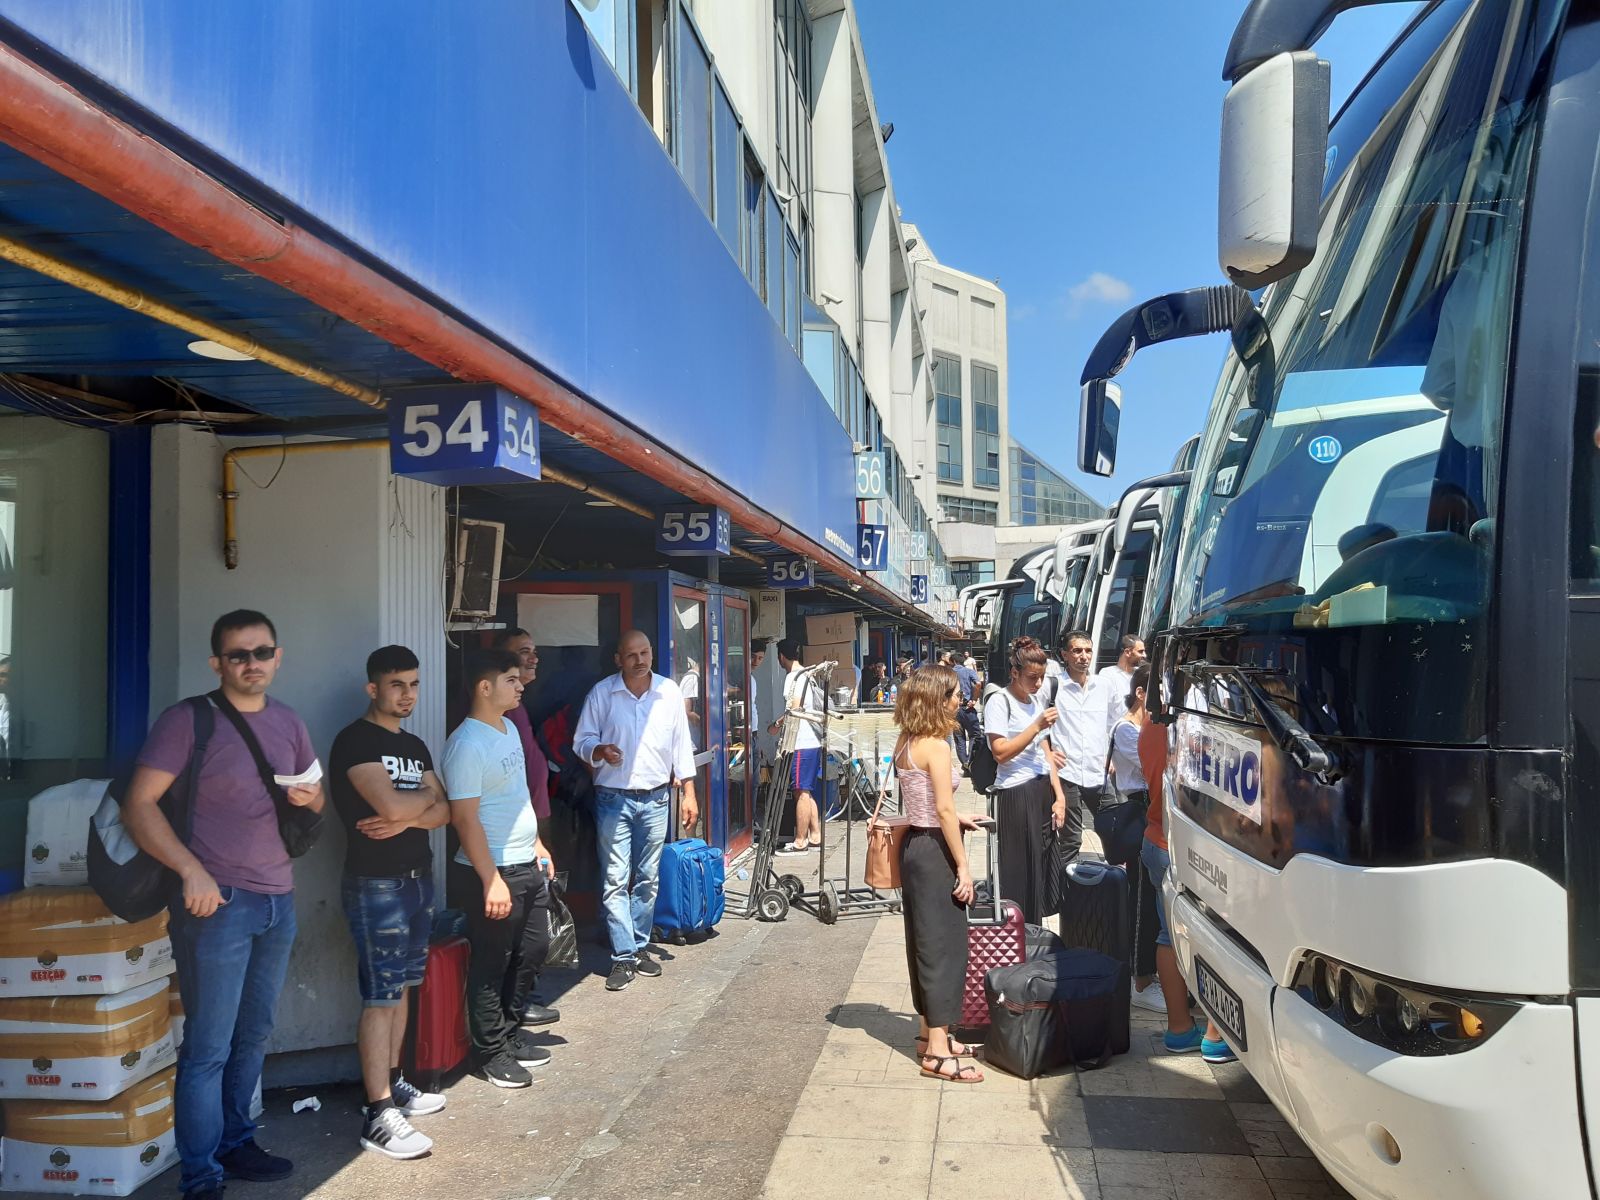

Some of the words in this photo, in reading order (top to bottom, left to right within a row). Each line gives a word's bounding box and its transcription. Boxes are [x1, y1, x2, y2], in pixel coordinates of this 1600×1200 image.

[402, 400, 490, 457] 54
[504, 406, 537, 465] 54
[1315, 440, 1337, 458] 110
[857, 456, 882, 495] 56
[661, 512, 711, 542] 55
[718, 514, 729, 547] 55
[861, 528, 886, 566] 57
[910, 534, 926, 558] 58
[911, 577, 926, 601] 59
[1187, 847, 1228, 894] NEOPLAN
